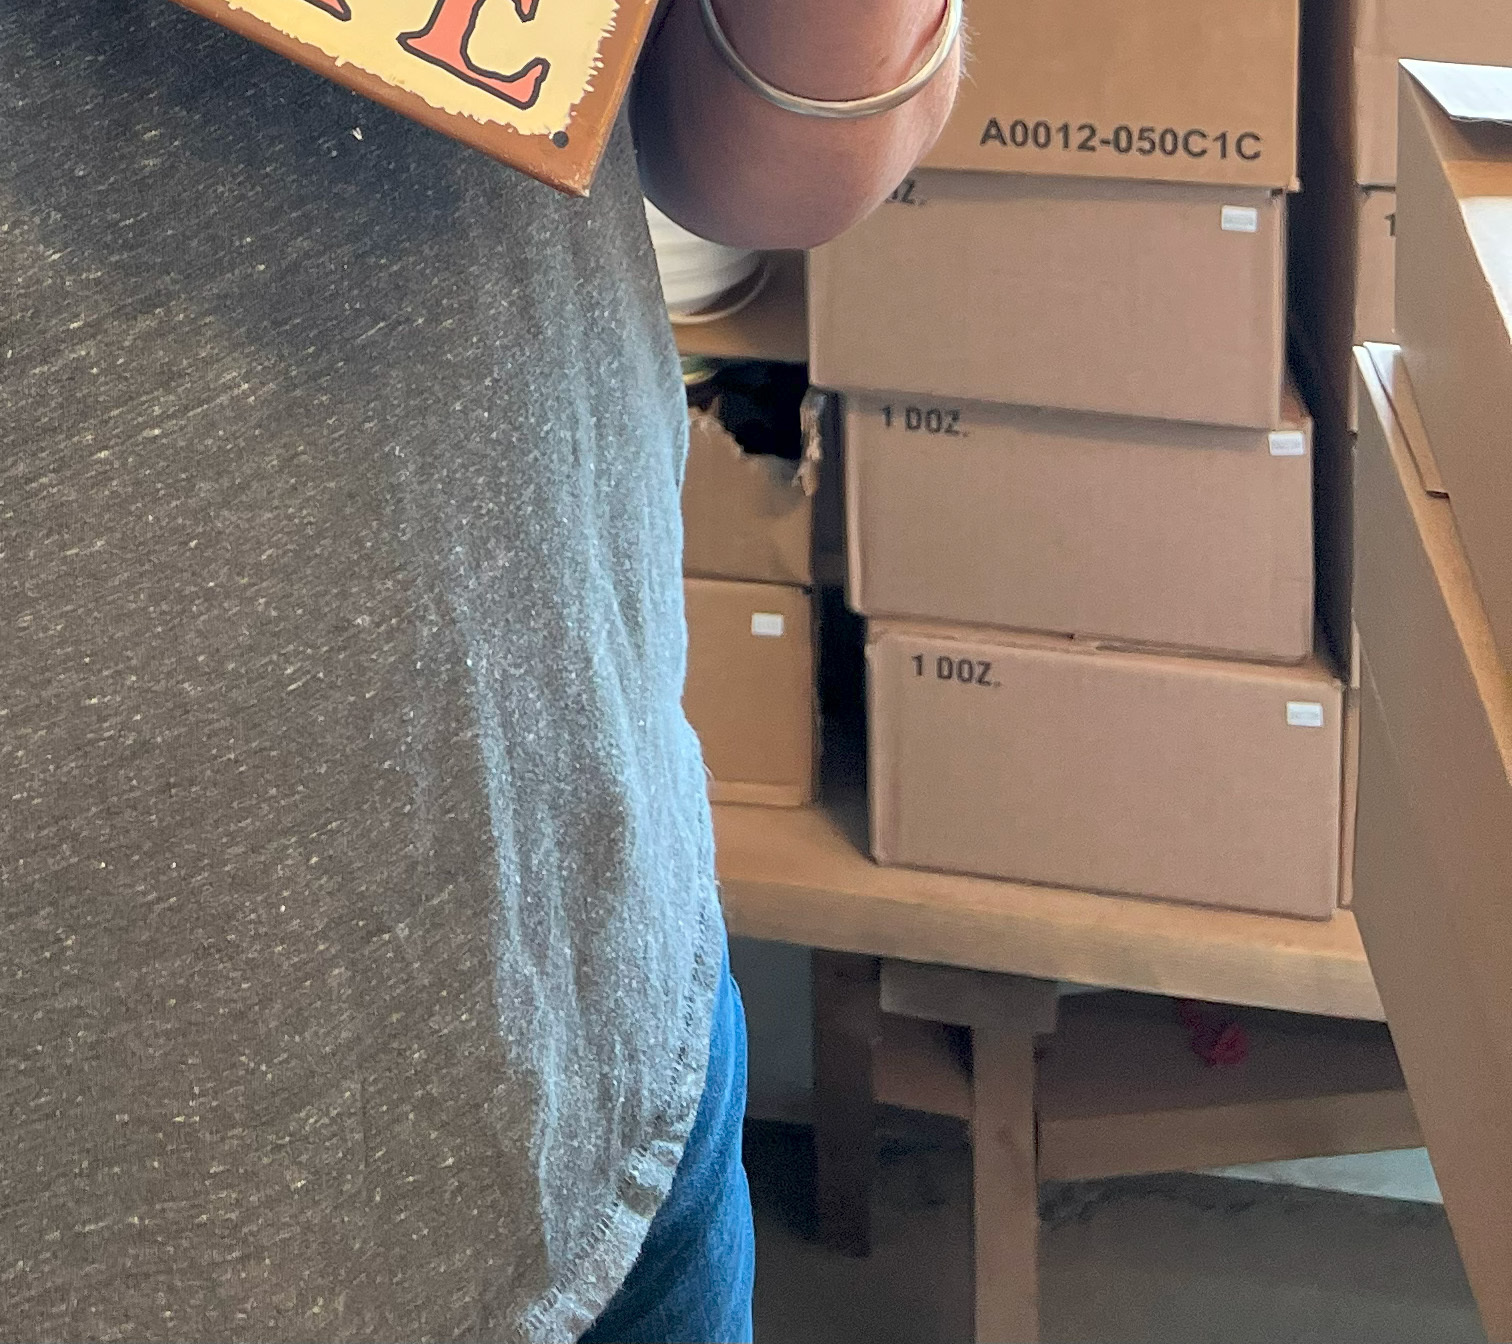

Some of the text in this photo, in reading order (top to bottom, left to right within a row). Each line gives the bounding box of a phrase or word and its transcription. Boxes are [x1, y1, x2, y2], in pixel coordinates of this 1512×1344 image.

[980, 117, 1263, 161] A0012-050C1C
[880, 405, 970, 438] 1 DOZ.
[911, 653, 1002, 687] 1 DOZ.
